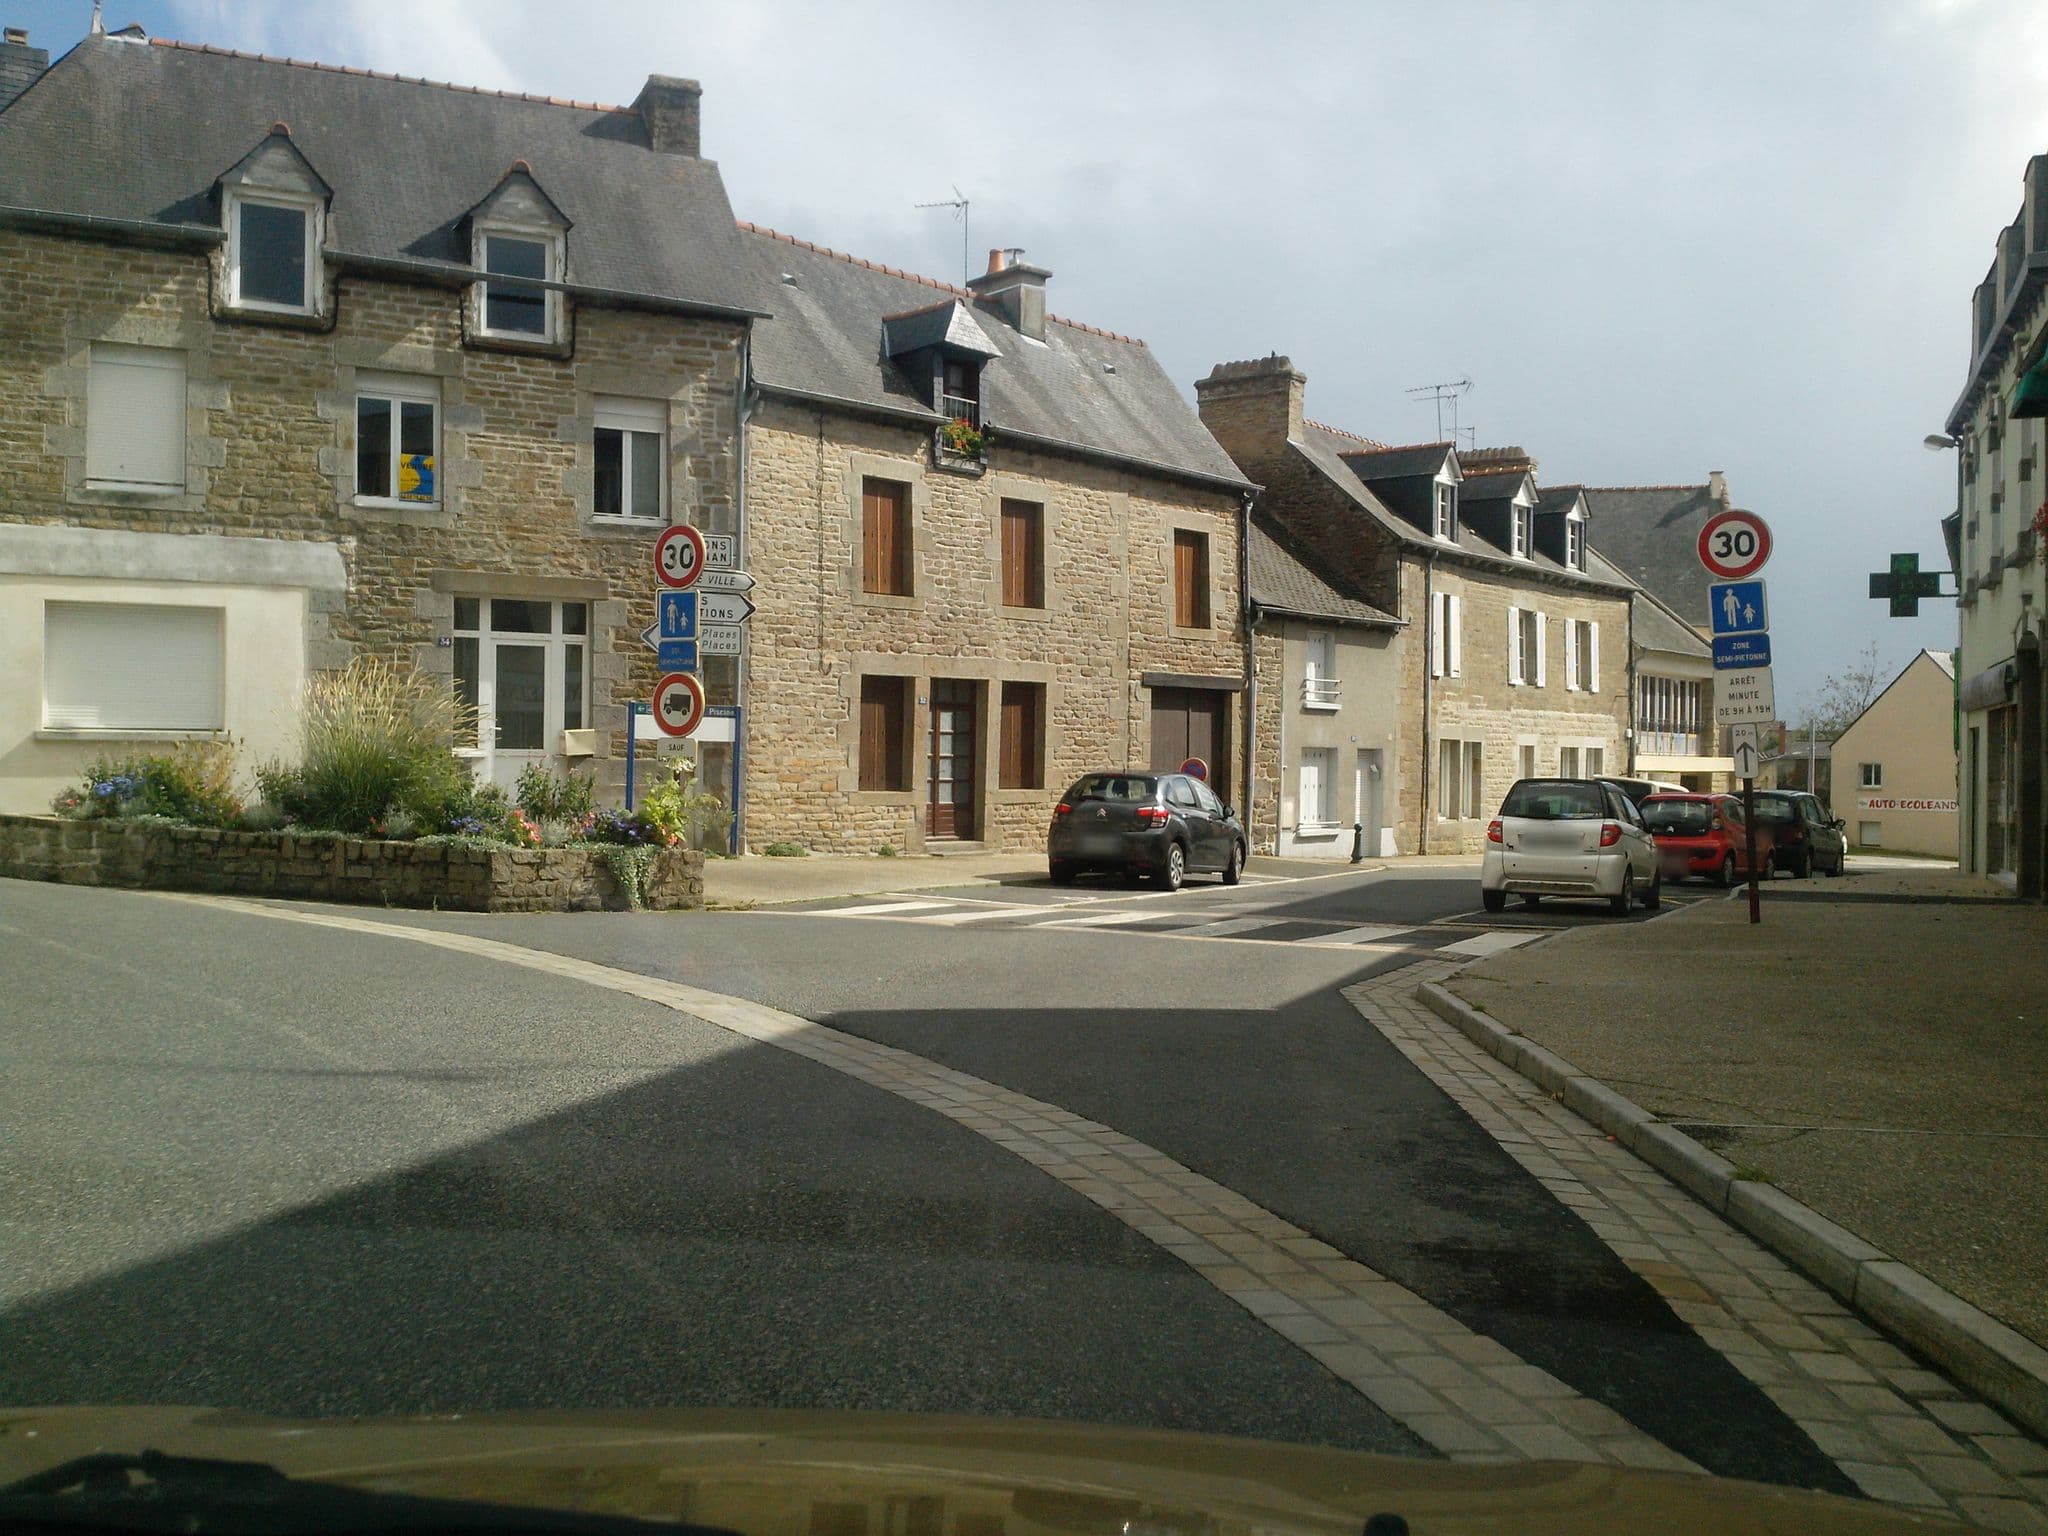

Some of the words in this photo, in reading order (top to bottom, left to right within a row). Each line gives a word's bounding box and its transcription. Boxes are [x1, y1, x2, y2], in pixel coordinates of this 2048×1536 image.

[1714, 530, 1755, 558] 30
[663, 543, 694, 570] 30
[708, 576, 736, 587] VILLE
[702, 628, 737, 639] Places
[701, 639, 737, 650] Places
[1732, 641, 1750, 650] ZONE
[1729, 674, 1756, 686] ARRÊT
[1728, 690, 1760, 701] MINUTE
[1720, 707, 1730, 716] DE
[1733, 706, 1744, 715] 9H
[1755, 705, 1771, 714] 19H
[668, 744, 685, 752] SAUF
